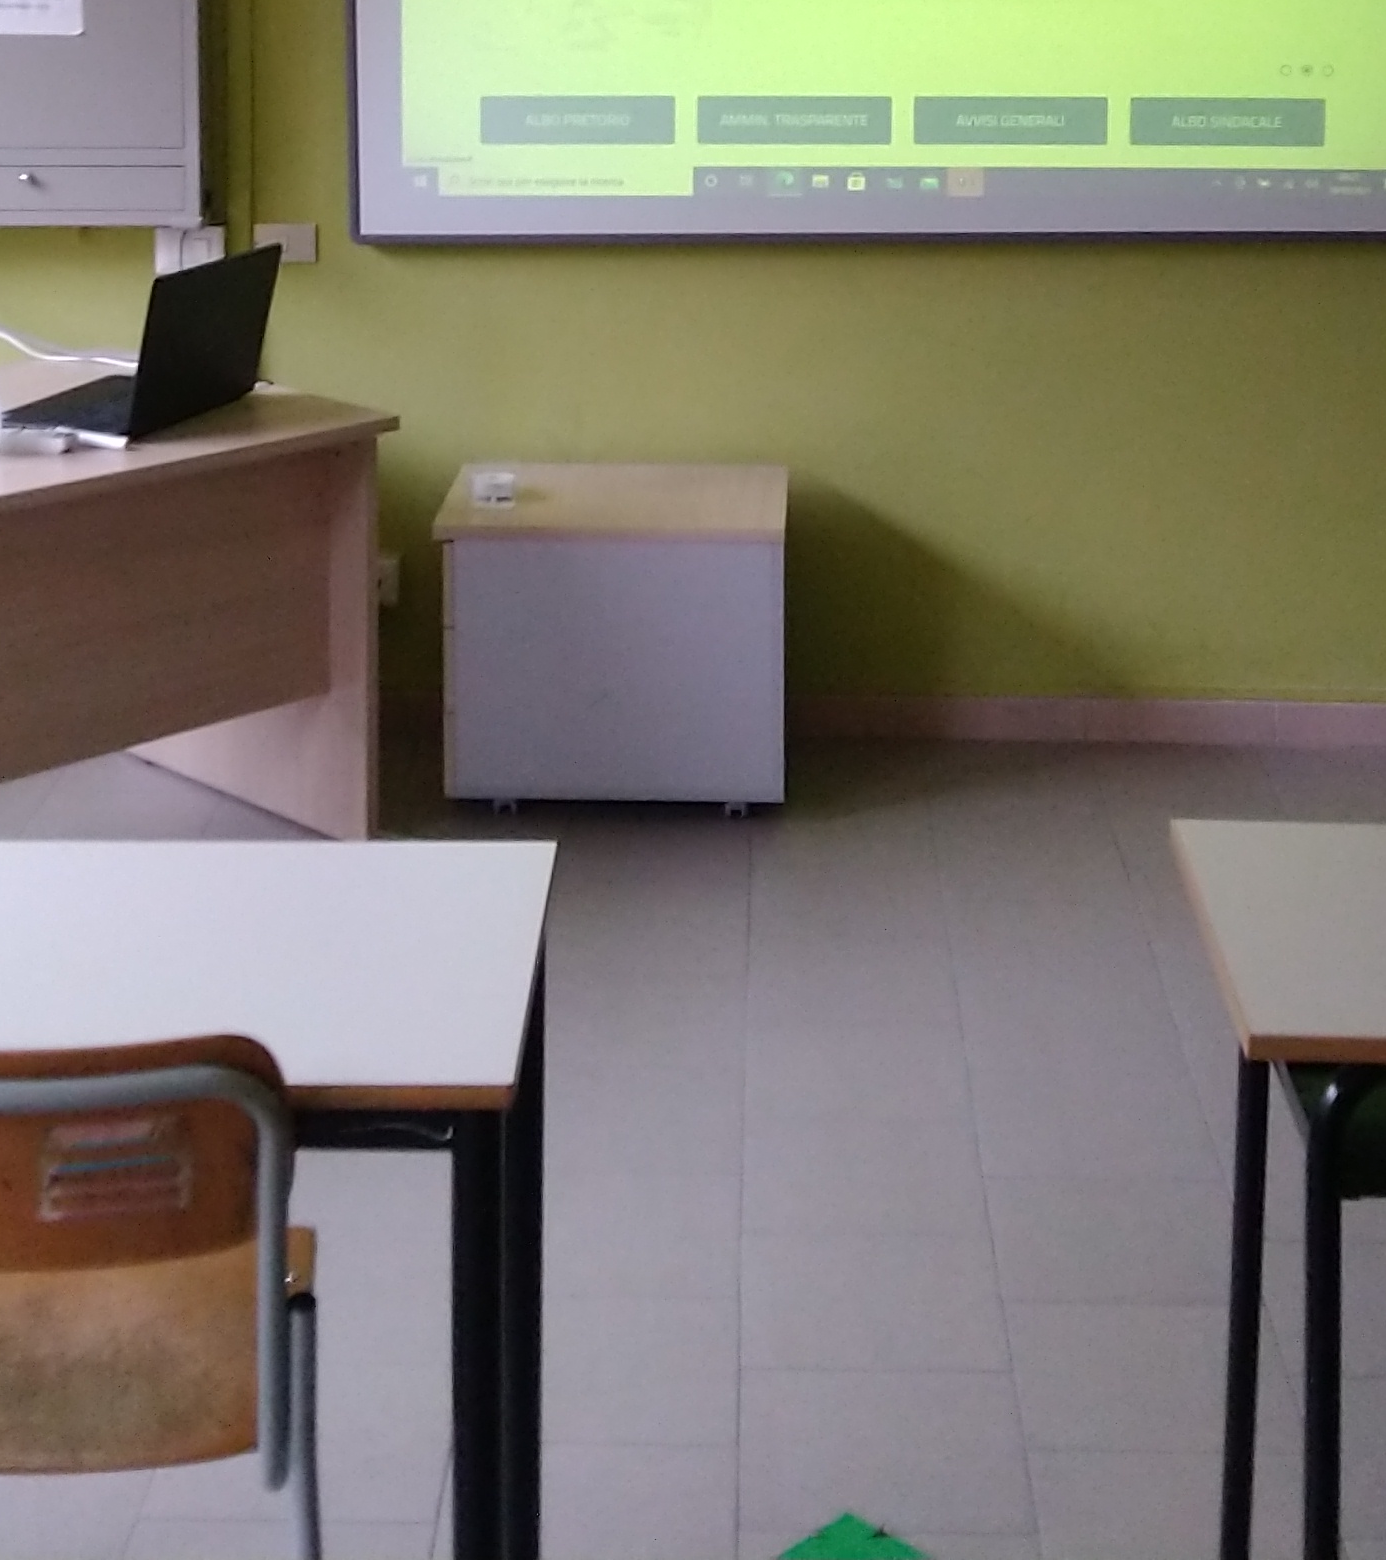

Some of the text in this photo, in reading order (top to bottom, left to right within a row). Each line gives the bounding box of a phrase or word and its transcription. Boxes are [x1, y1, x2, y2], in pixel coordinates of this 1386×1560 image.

[524, 114, 631, 128] ALBO PRETORIO
[775, 113, 869, 128] TRASPARENTE
[955, 114, 1065, 128] AVVISI GENERALI
[1171, 114, 1283, 129] ALBO SINDACALE
